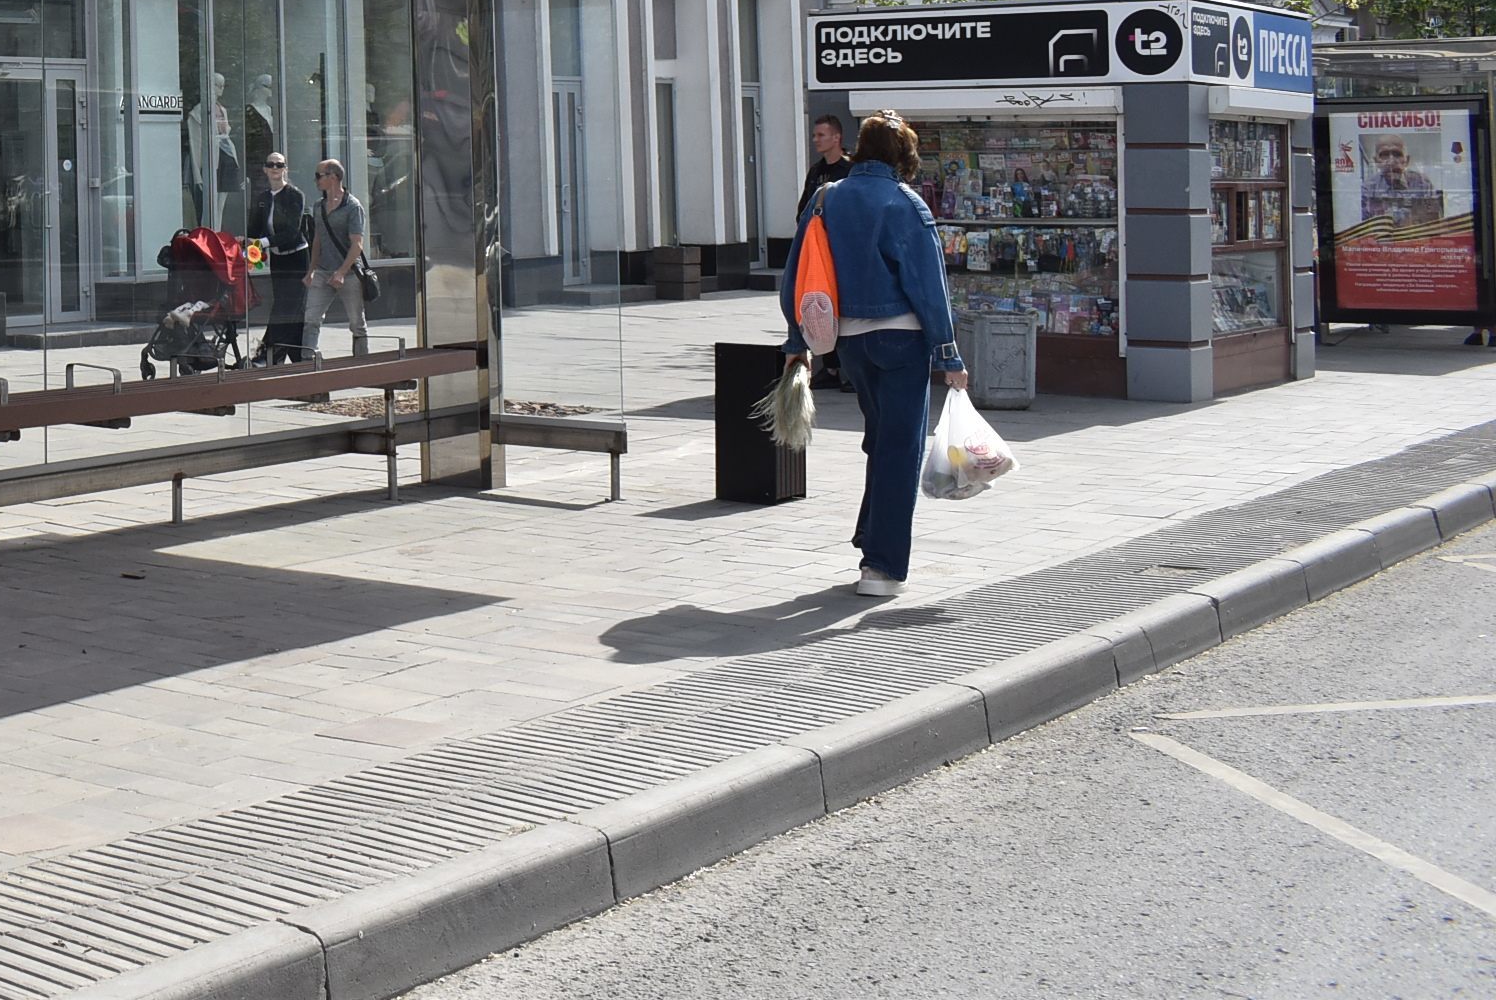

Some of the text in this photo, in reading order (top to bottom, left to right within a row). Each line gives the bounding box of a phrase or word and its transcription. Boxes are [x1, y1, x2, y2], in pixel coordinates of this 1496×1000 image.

[1193, 12, 1228, 27] ПОДКЛЮЧИТЕ
[820, 22, 991, 44] ПОДКЛЮЧИТЕ
[1193, 25, 1210, 37] ЗДЕСЬ
[821, 48, 903, 67] ЗДЕСЬ
[1259, 29, 1308, 77] ПРЕССА
[1357, 111, 1441, 128] СПАСИБО!
